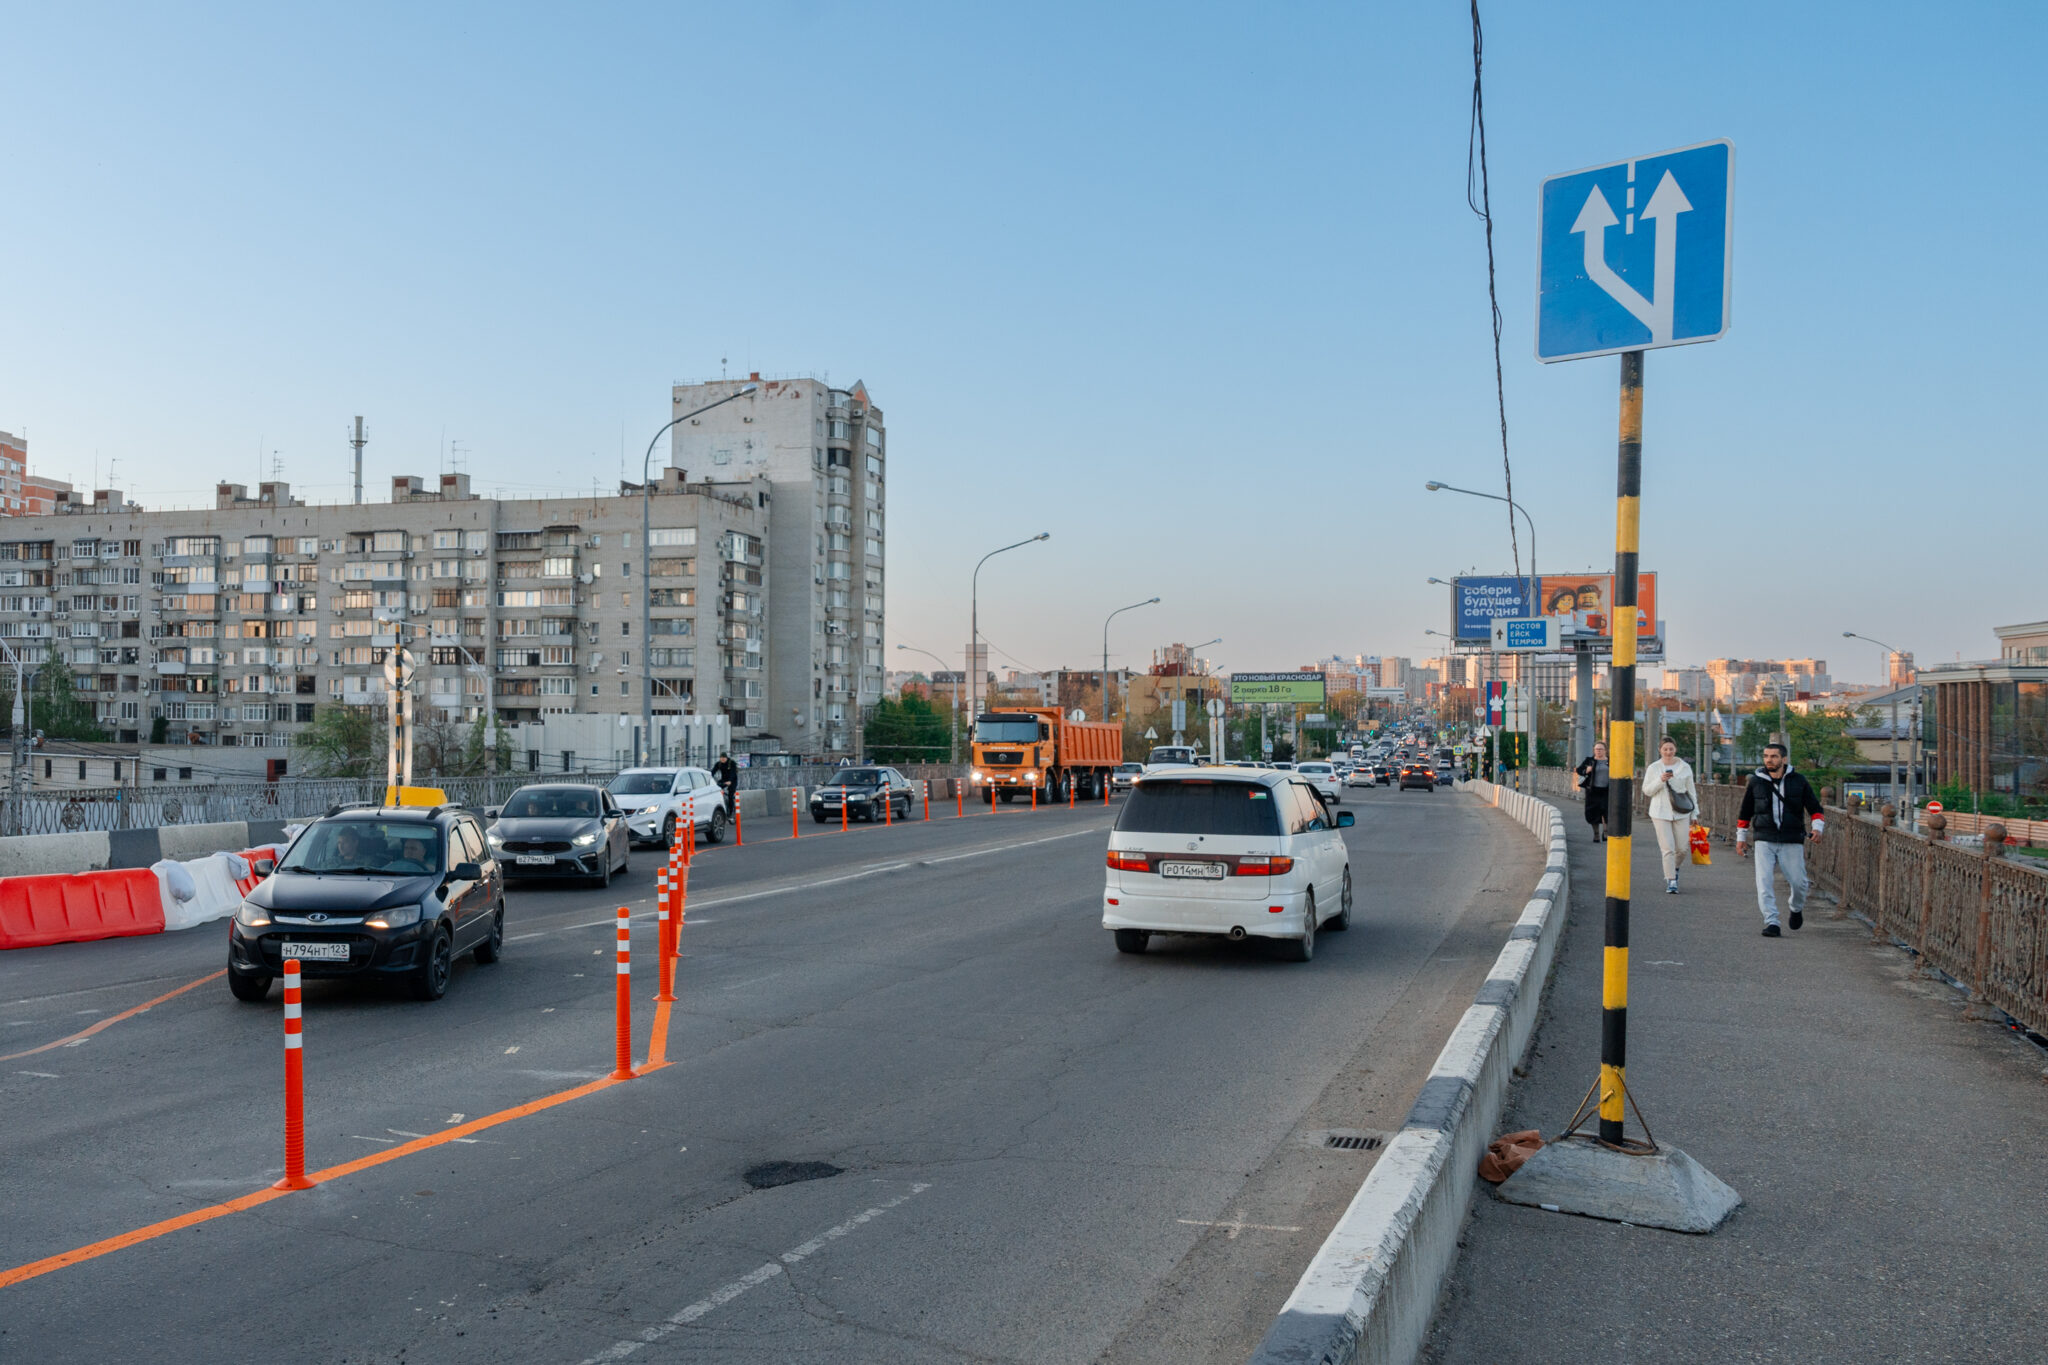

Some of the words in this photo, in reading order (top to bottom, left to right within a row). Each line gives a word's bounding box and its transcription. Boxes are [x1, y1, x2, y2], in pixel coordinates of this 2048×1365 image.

[1464, 585, 1512, 598] собери
[1464, 596, 1521, 608] будущее
[1464, 607, 1519, 618] сегодня
[1510, 630, 1530, 638] ЕЙСК
[1234, 674, 1248, 682] ЭТО
[1249, 673, 1276, 681] НОВЫЙ
[1277, 673, 1322, 681] КРАСНОДАР
[1233, 685, 1240, 693] 2
[1241, 686, 1267, 694] парка
[1269, 685, 1280, 693] 18
[1166, 865, 1204, 875] Р014МН
[285, 944, 327, 956] Н794НТ
[330, 944, 347, 954] 123
